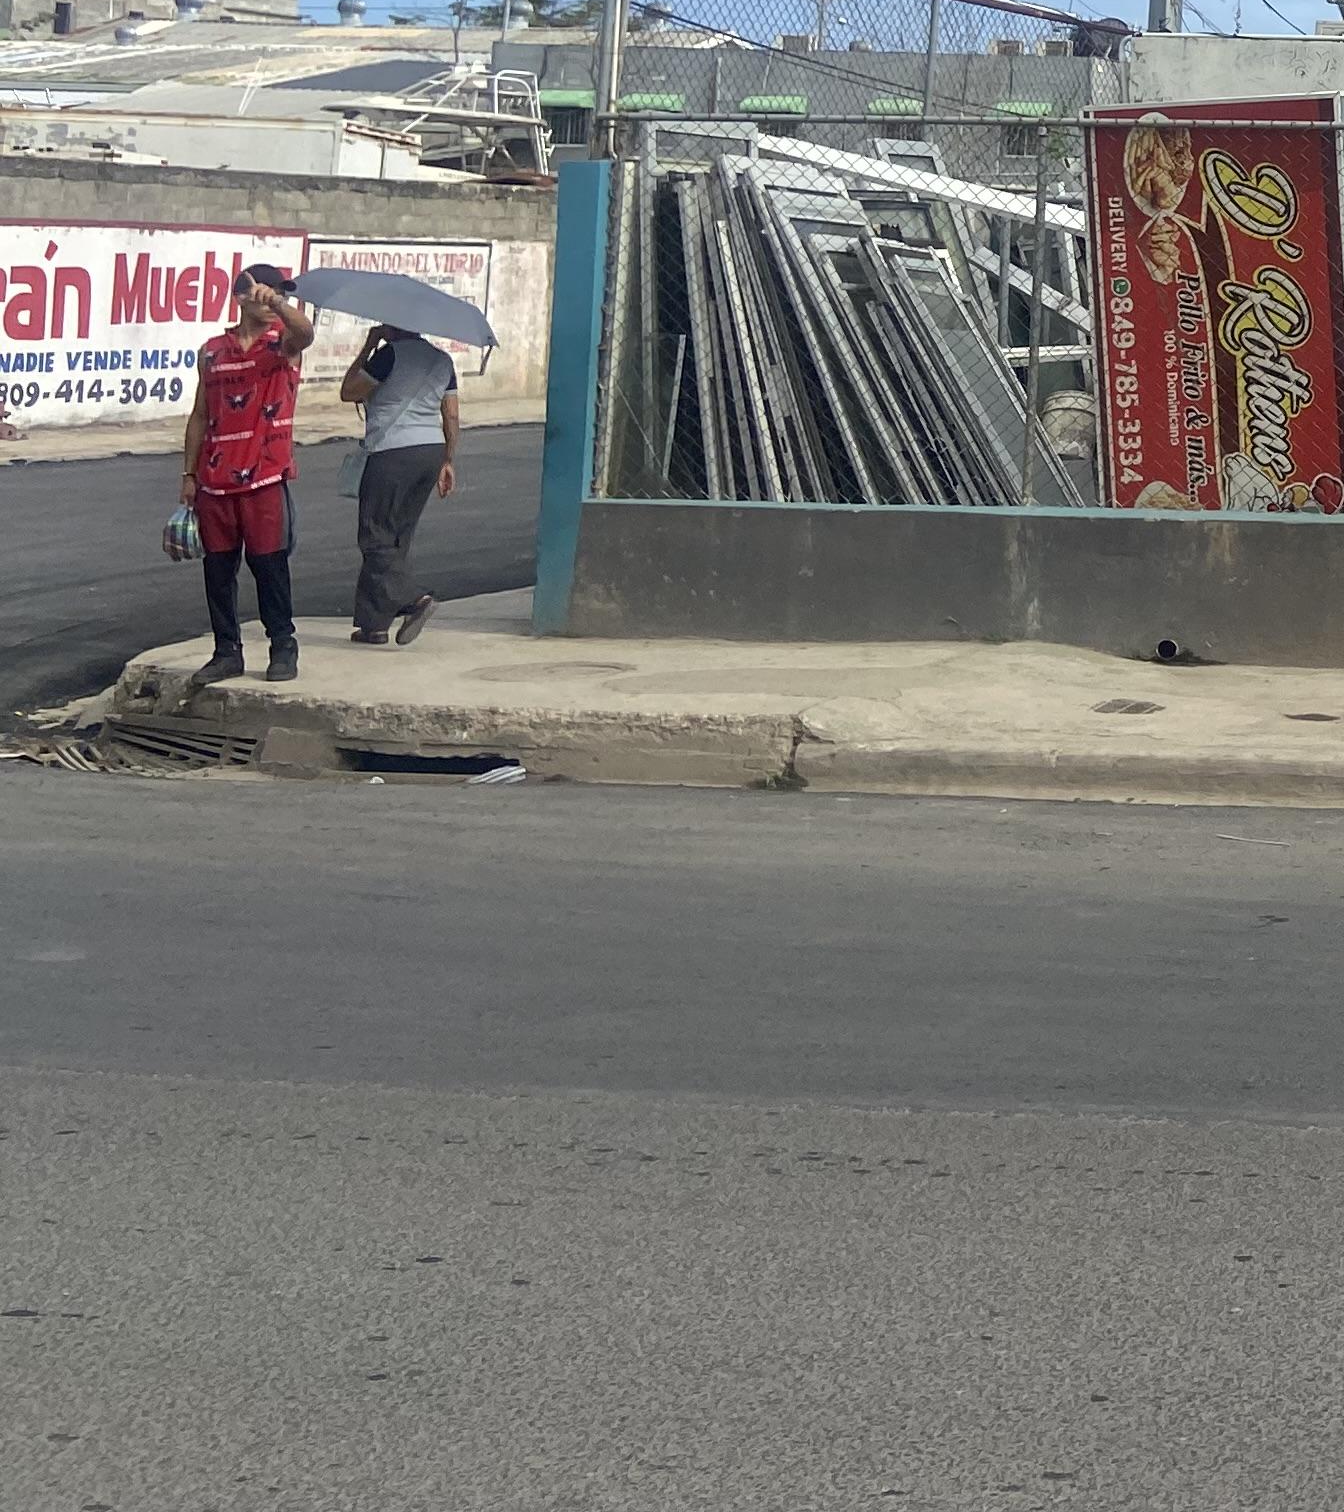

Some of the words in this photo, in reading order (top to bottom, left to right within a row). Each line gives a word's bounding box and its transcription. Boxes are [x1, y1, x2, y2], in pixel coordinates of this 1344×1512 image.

[340, 250, 400, 272] MUNDO
[1107, 196, 1128, 273] DELIVERY
[0, 239, 91, 340] án
[110, 251, 293, 325] Muebl
[1176, 270, 1205, 334] Pollo
[0, 352, 55, 373] NADIE
[66, 350, 132, 371] VENDE
[141, 349, 196, 370] MEJO
[1164, 329, 1177, 353] 100
[1165, 356, 1178, 370] %
[1181, 338, 1208, 400] Frito
[1109, 296, 1144, 485] 849-785-3334
[1222, 267, 1312, 482] Rothens
[1166, 372, 1181, 446] Dominicano
[1184, 407, 1211, 430] &
